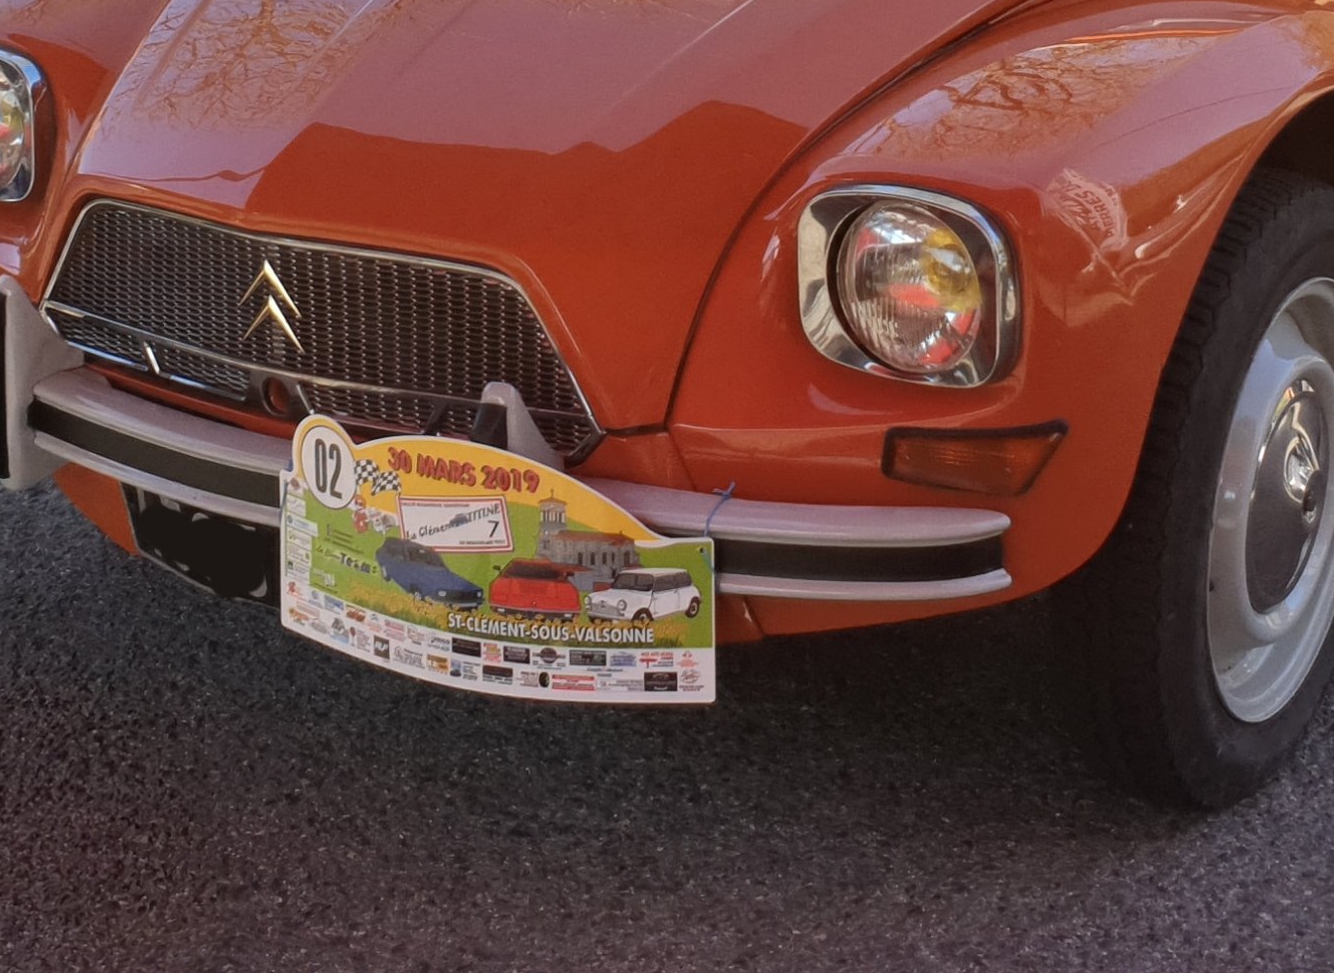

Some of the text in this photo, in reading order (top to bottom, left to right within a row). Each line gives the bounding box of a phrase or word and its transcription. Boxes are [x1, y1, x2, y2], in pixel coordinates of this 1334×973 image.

[315, 438, 343, 499] 02
[388, 446, 540, 493] 30 MARS 2019
[487, 520, 500, 538] 7
